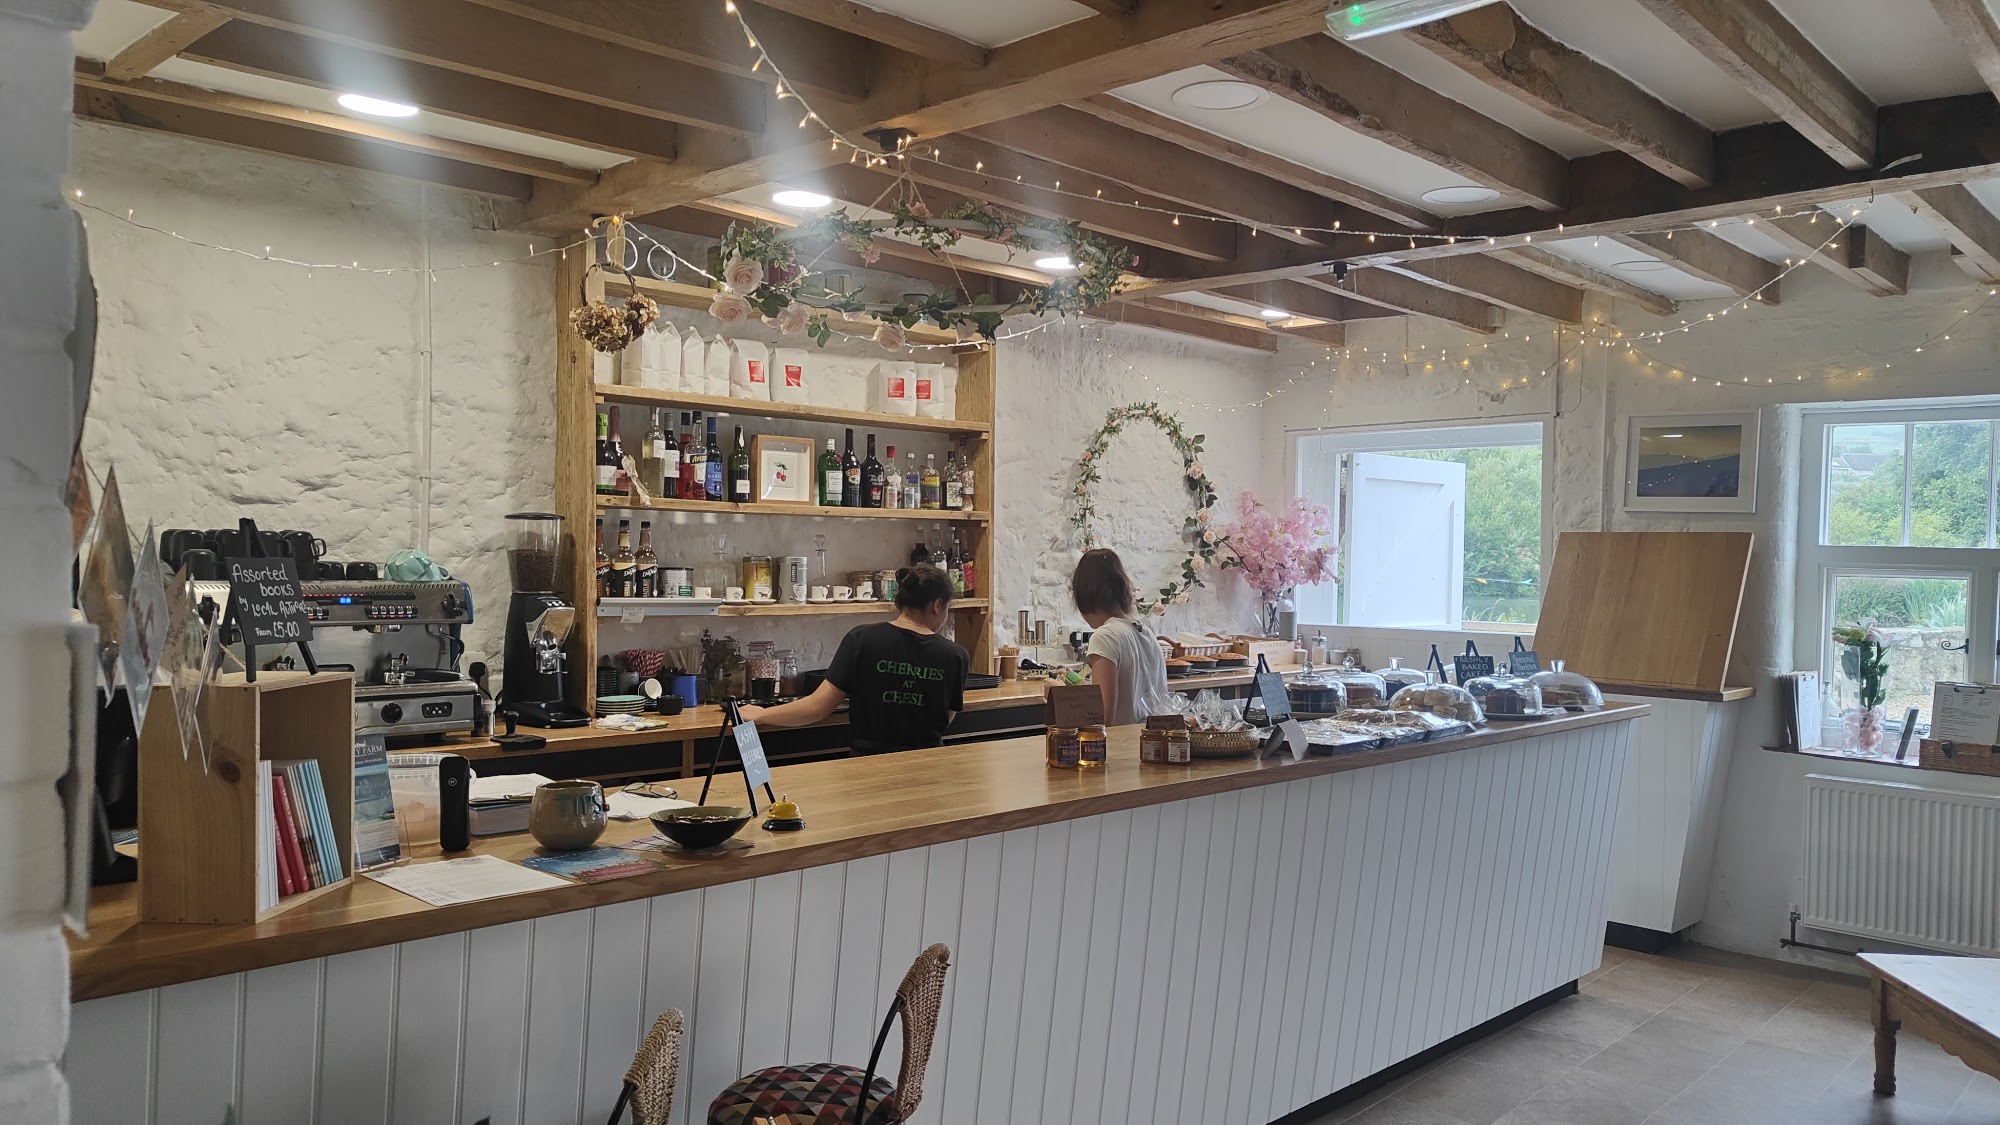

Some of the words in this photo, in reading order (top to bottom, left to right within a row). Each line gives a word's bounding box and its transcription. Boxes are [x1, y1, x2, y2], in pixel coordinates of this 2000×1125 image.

[232, 563, 289, 583] Assorted
[259, 582, 294, 597] books
[238, 595, 249, 611] by
[1454, 655, 1489, 663] FRESHLY
[876, 659, 945, 681] CHERRIES
[1461, 663, 1489, 671] BAKED
[1460, 671, 1488, 679] CAKES
[902, 680, 916, 689] AT
[362, 745, 383, 754] FARM
[552, 795, 602, 815] TIPS
